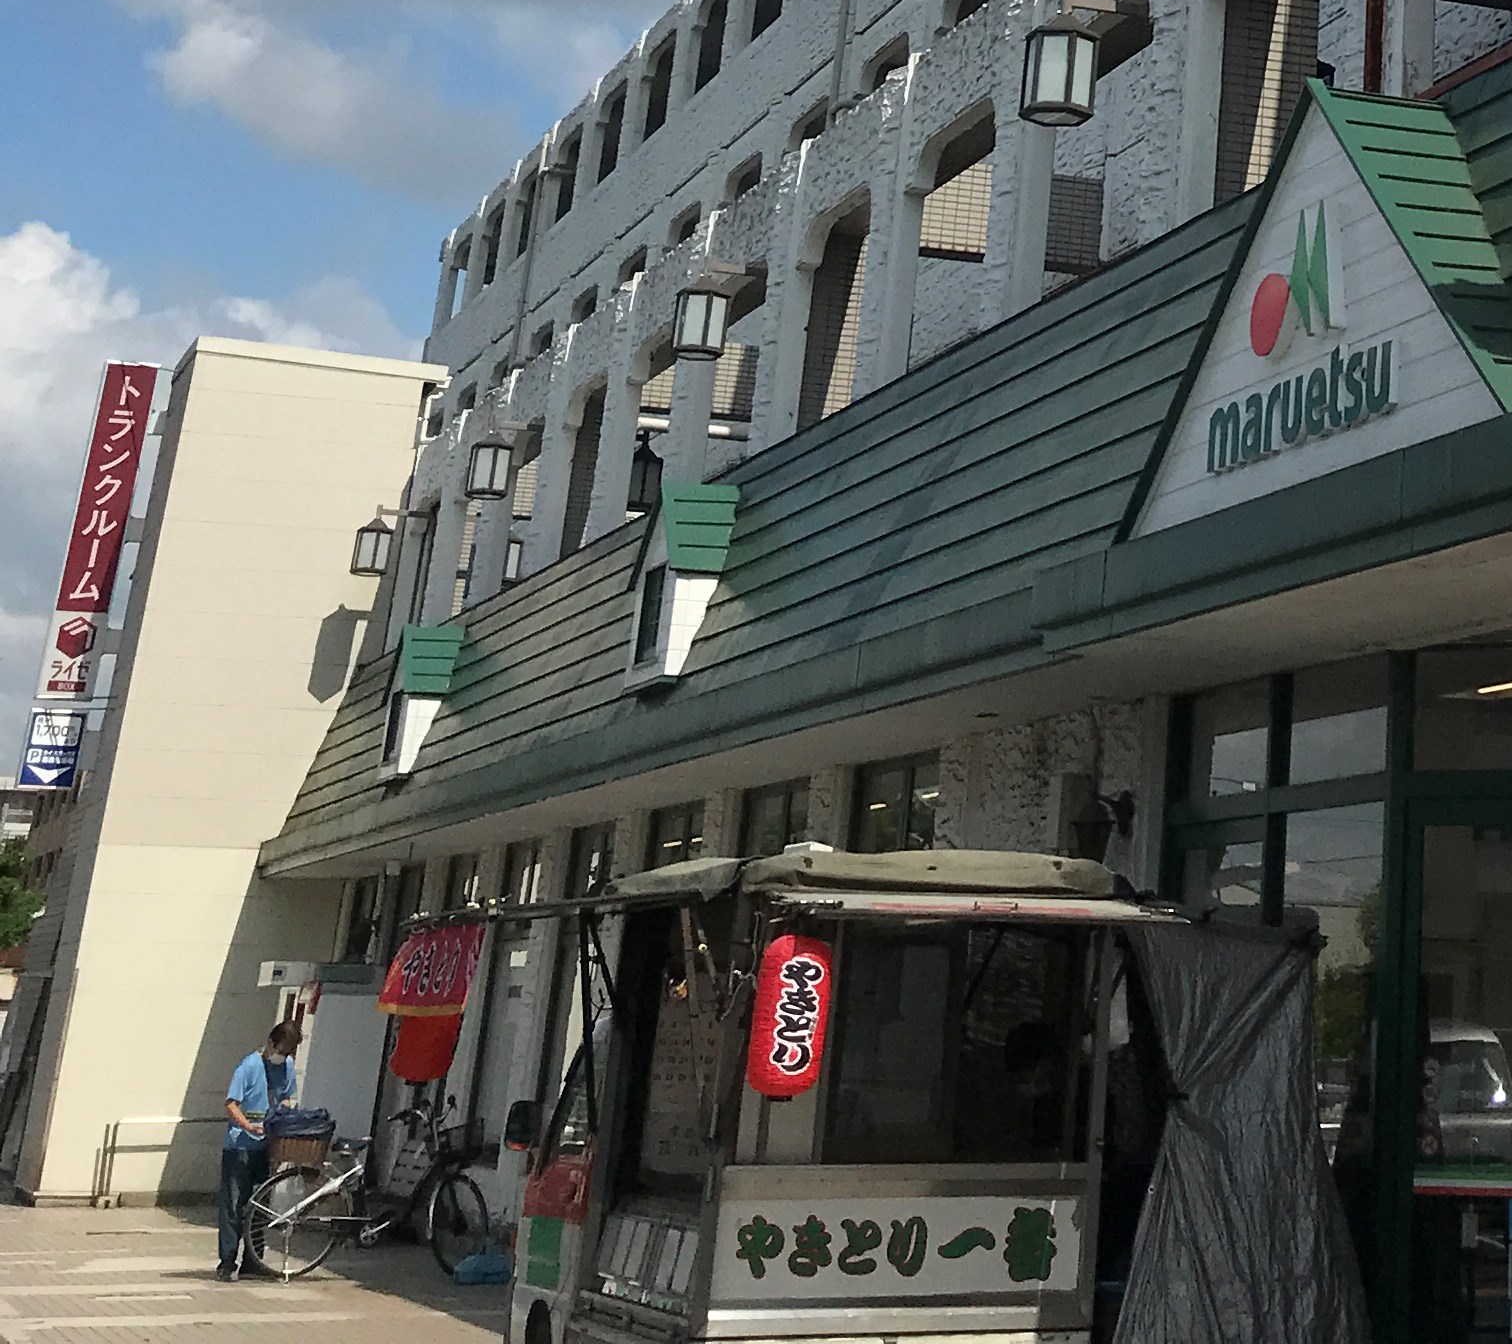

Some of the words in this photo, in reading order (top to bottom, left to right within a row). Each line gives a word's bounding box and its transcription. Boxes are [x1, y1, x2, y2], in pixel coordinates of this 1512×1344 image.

[1206, 340, 1393, 474] maruetsu
[67, 374, 142, 603] トランクルーム
[51, 659, 91, 681] ライゼ
[771, 959, 823, 1073] やきとり
